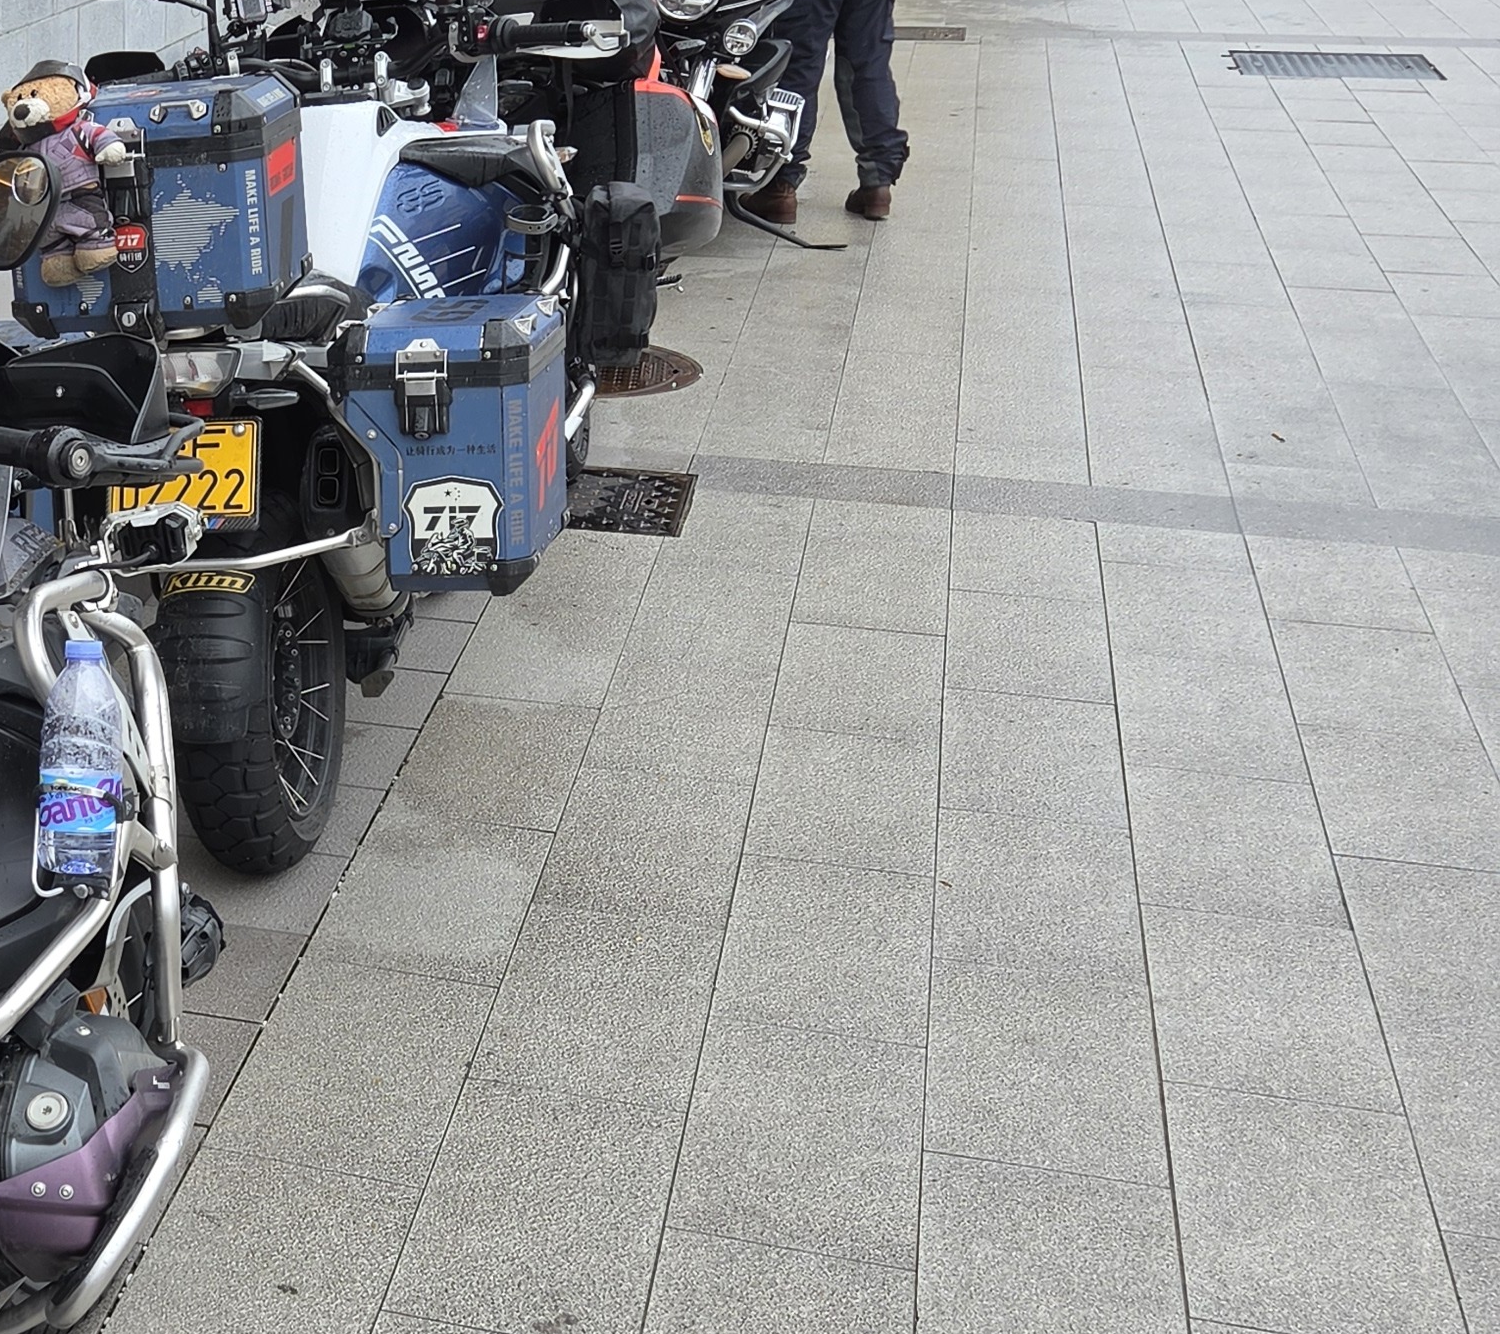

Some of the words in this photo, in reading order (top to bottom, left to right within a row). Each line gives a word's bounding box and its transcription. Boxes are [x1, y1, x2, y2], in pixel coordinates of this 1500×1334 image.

[244, 169, 259, 206] MAKE
[247, 207, 260, 234] LIFE
[249, 235, 261, 246] A
[250, 248, 263, 276] RIDE
[507, 399, 524, 448] MAKE
[508, 451, 524, 488] LIFE
[510, 492, 524, 505] A
[510, 508, 525, 546] RIDE
